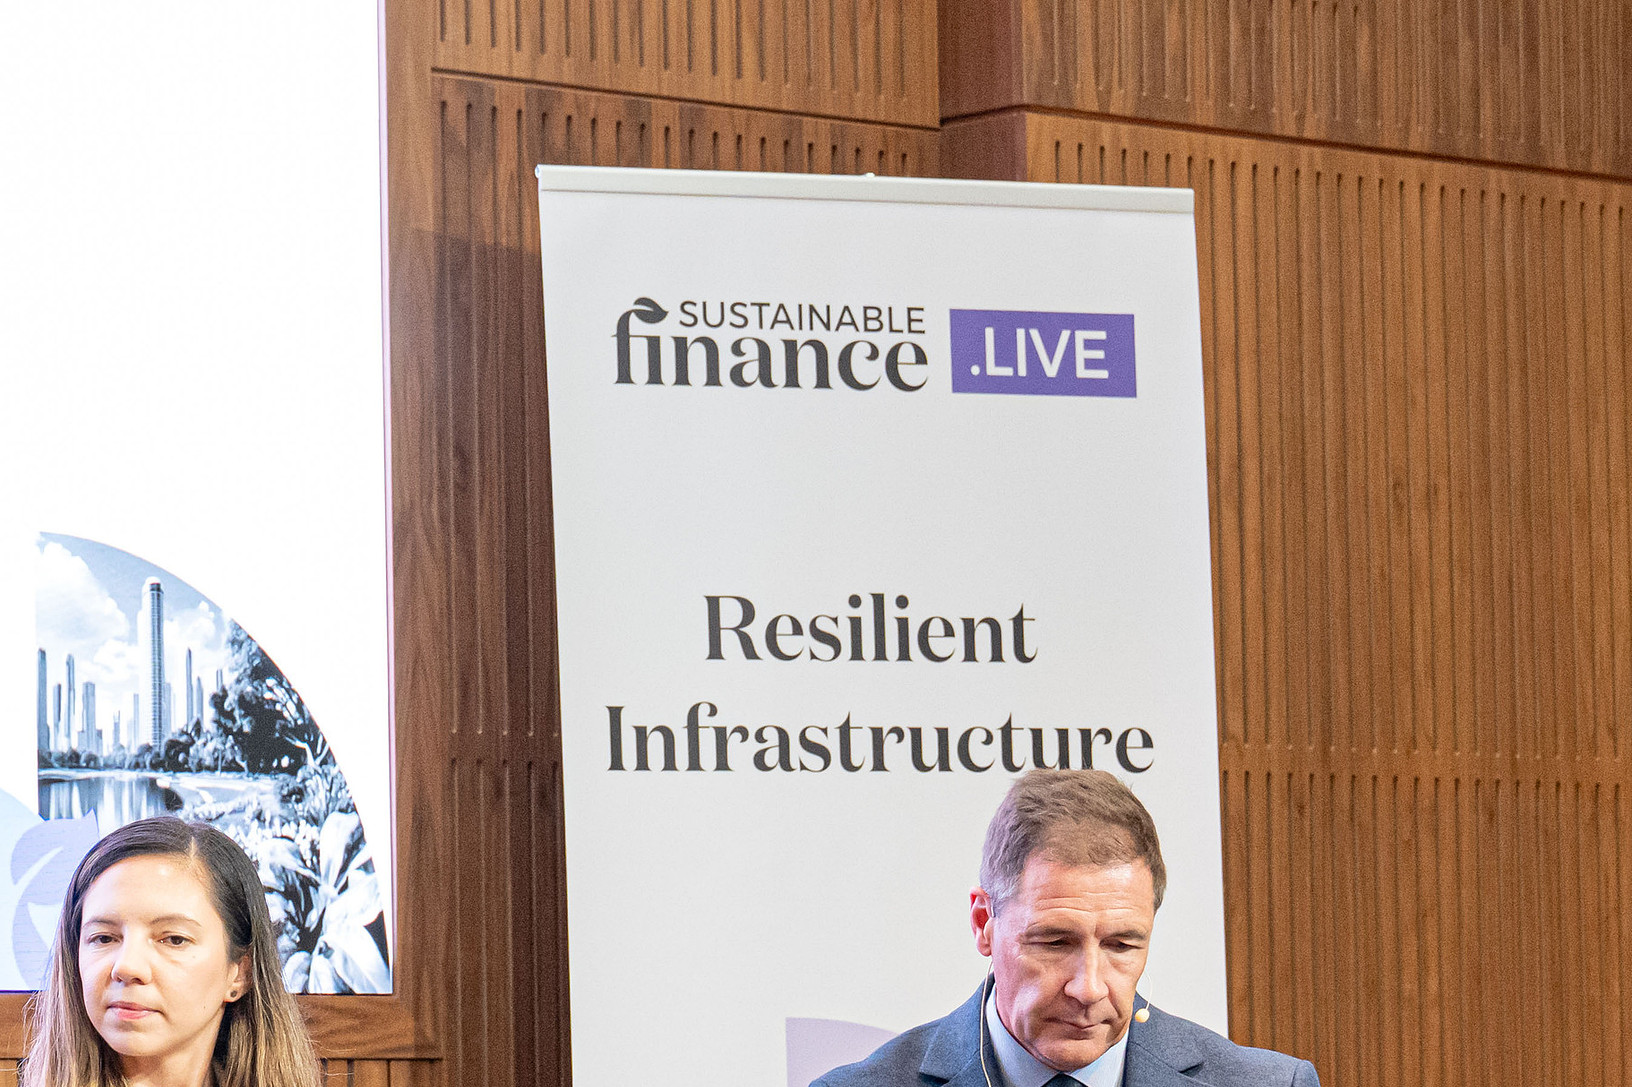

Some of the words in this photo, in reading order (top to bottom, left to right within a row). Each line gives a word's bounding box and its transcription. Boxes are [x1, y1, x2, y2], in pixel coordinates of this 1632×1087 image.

[611, 297, 929, 392] finance
[969, 326, 1110, 381] .LIVE
[678, 300, 926, 335] SUSTAINABLE
[703, 592, 1039, 664] Resilient
[605, 700, 1155, 774] Infrastructure
